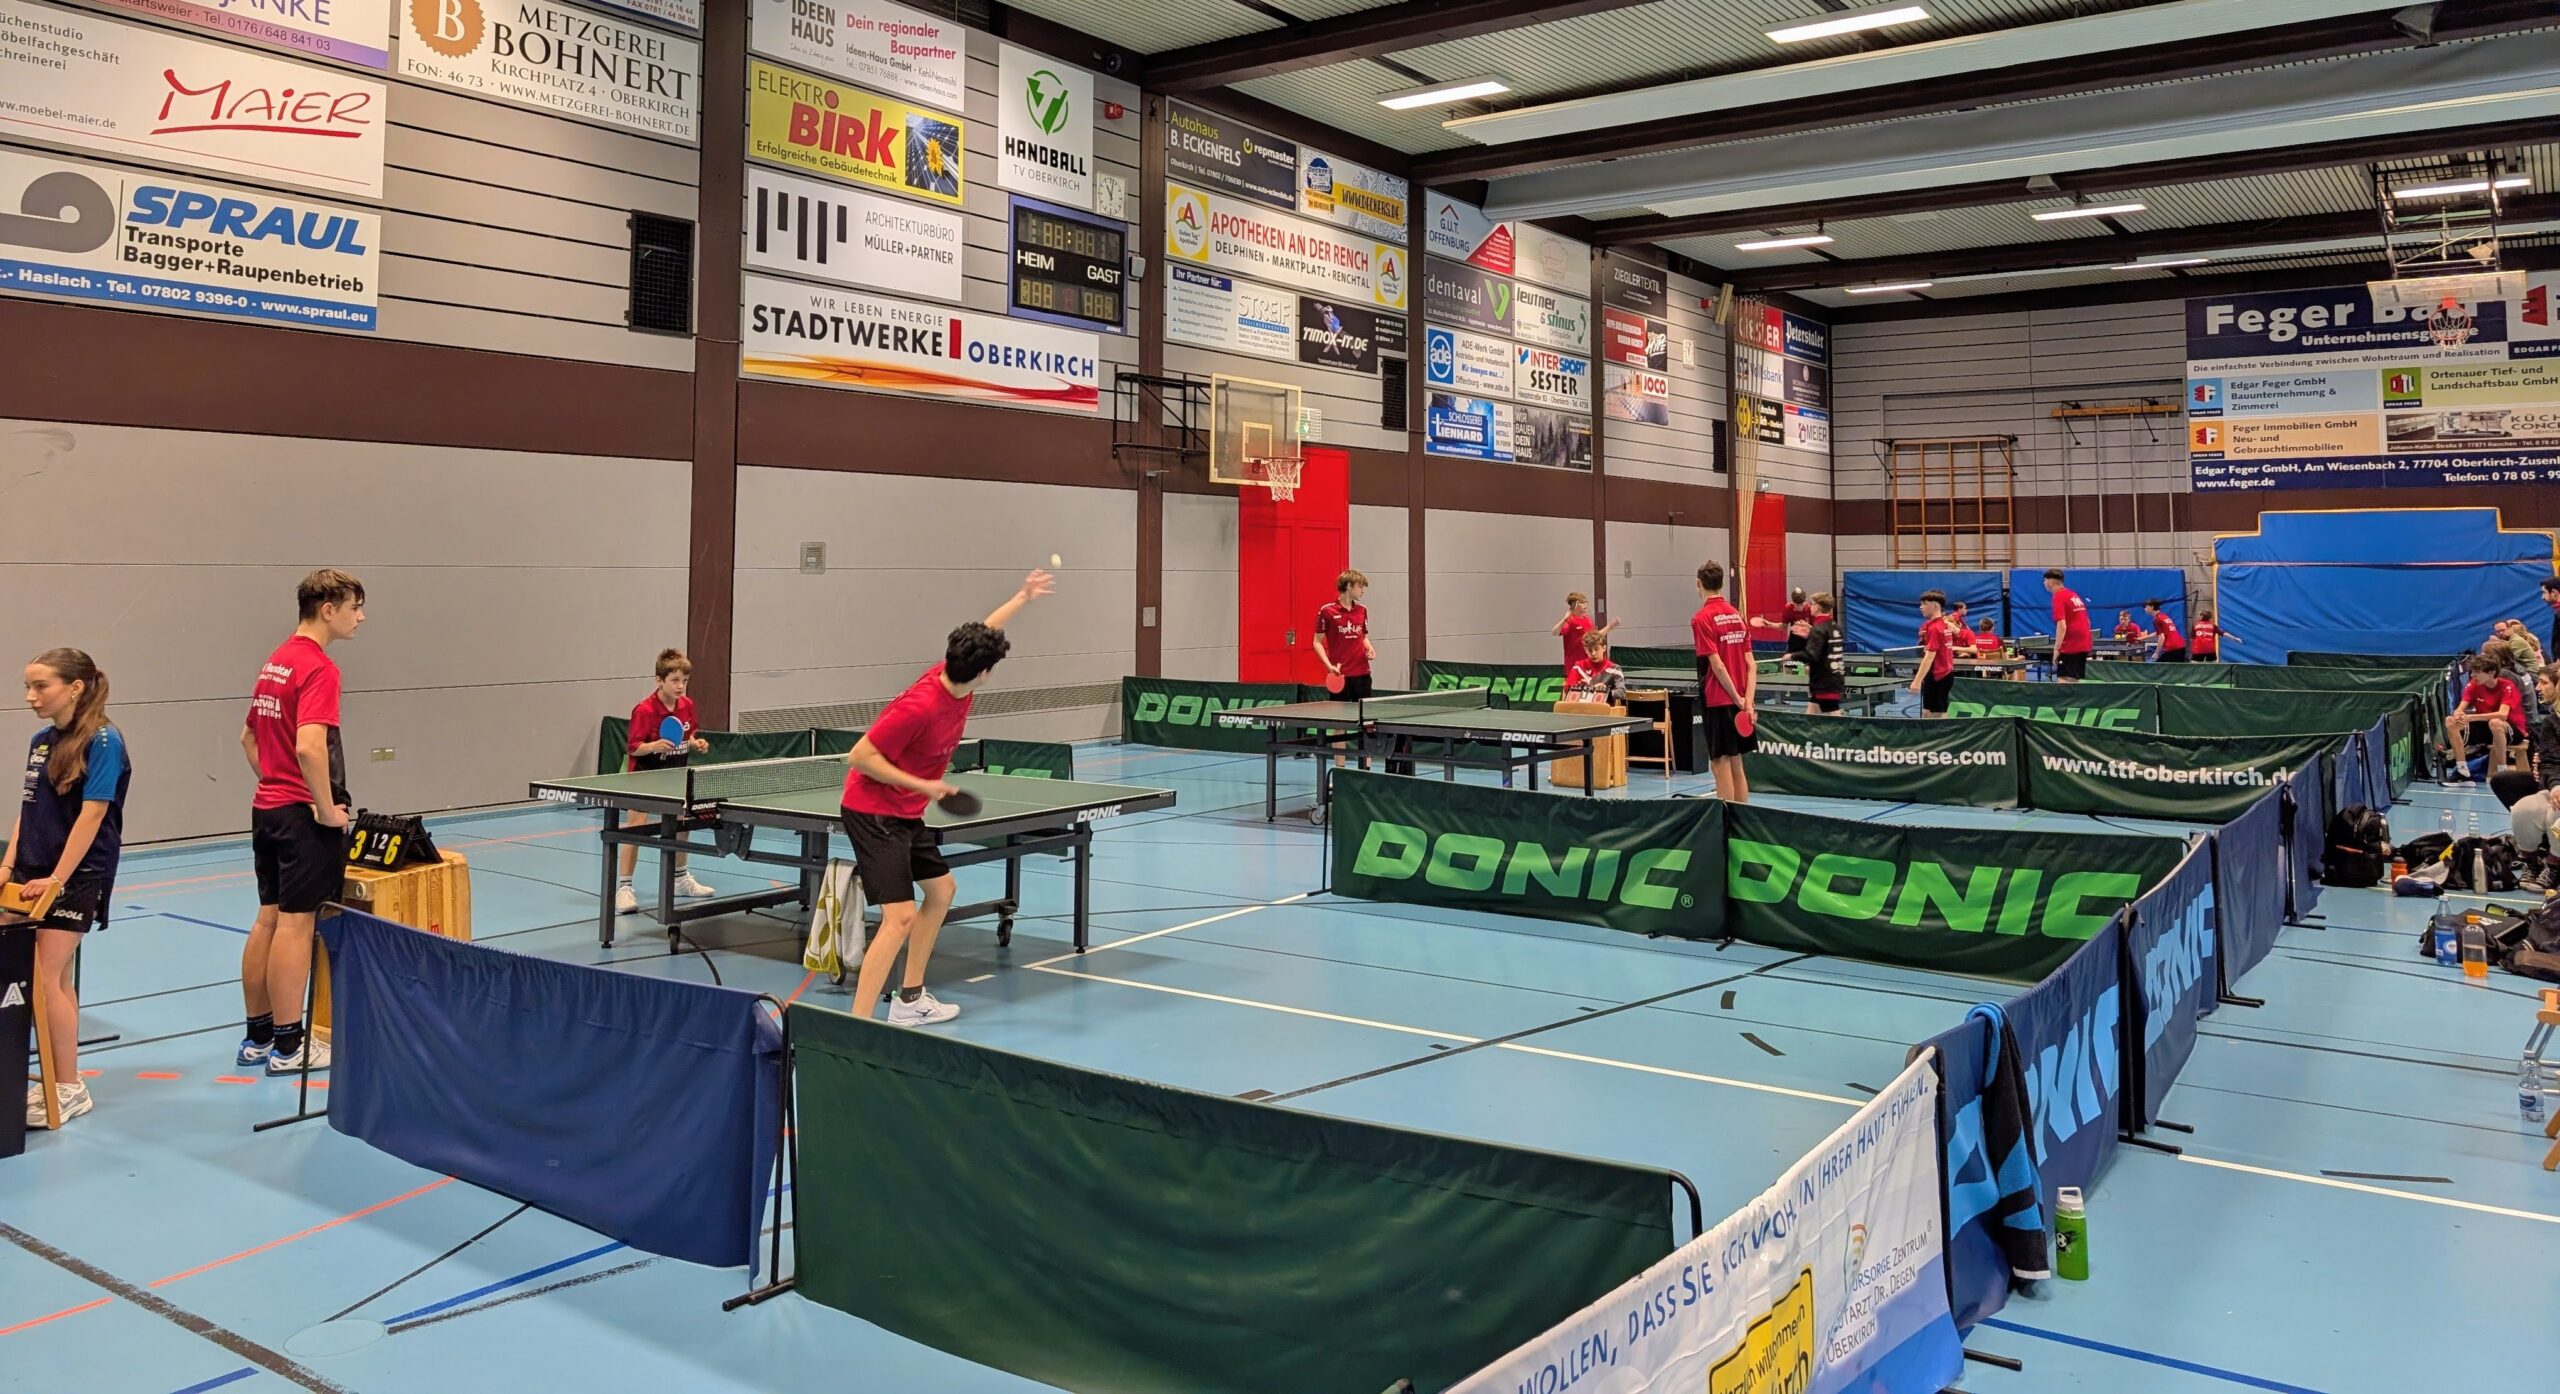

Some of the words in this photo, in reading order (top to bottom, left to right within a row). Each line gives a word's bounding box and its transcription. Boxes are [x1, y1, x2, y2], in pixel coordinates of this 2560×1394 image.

[791, 0, 836, 27] IDEEN
[846, 14, 874, 31] Dein
[879, 20, 940, 39] regionaler
[203, 11, 223, 25] Tel.
[291, 33, 311, 47] 841
[316, 38, 330, 51] 03
[518, 3, 666, 62] METZGEREI
[791, 17, 835, 48] HAUS
[0, 31, 120, 65] öbelfachgeschäft
[492, 22, 691, 101] BOHNERT
[846, 43, 888, 66] Ideen-Haus
[890, 58, 912, 73] GmbH
[891, 40, 957, 60] Baupartner
[407, 58, 443, 78] FON:
[448, 70, 464, 84] 46
[468, 75, 484, 88] 73
[490, 59, 585, 94] KIRCHPLATZ
[589, 86, 597, 97] 4
[611, 89, 690, 119] OBERKIRCH
[758, 71, 840, 110] ELEKTRO
[1171, 111, 1219, 140] Autohaus
[757, 140, 818, 166] Erfolgreiche
[820, 155, 898, 184] Gebäudetechnik
[1005, 136, 1087, 177] HANDBALL
[1171, 129, 1181, 148] B.
[1183, 133, 1242, 167] ECKENFELS
[1254, 145, 1295, 166] repmaster
[1013, 163, 1026, 177] TV
[1028, 167, 1081, 192] OBERKIRCH
[127, 186, 367, 256] SPRAUL
[865, 211, 955, 243] ARCHITEKTURBÜRO
[1440, 218, 1460, 235] G.U.T.
[125, 225, 245, 259] Transporte
[864, 233, 955, 266] MÜLLER+PARTNER
[1211, 211, 1286, 251] APOTHEKEN
[1289, 232, 1306, 257] AN
[1309, 237, 1332, 263] DER
[1334, 245, 1369, 273] RENCH
[1429, 229, 1470, 253] OFFENBURG
[124, 246, 365, 293] Bagger+Raupenbetrieb
[1017, 250, 1055, 272] HEIM
[1087, 264, 1121, 285] GAST
[1176, 269, 1186, 280] Ihr
[1187, 272, 1210, 284] Partner
[1211, 277, 1222, 288] für:
[1215, 240, 1265, 263] DELPHINEN
[1272, 255, 1326, 278] MARKTPLATZ
[1333, 271, 1370, 289] RENCHTAL
[19, 269, 91, 290] Haslach
[107, 280, 137, 295] Tel.
[141, 285, 191, 302] 07802
[196, 291, 248, 308] 9396-0
[261, 301, 369, 324] www.spraul.eu
[1428, 274, 1482, 305] dentaval
[810, 295, 837, 311] WIR
[845, 300, 884, 319] LEBEN
[891, 308, 944, 328] ENERGIE
[2206, 303, 2355, 343] Feger
[752, 304, 944, 358] STADTWERKE
[968, 341, 1095, 379] OBERKIRCH
[1430, 344, 1452, 366] ade
[1489, 346, 1505, 357] GmbH
[2514, 346, 2550, 354] EDGAR
[1531, 350, 1586, 377] INTERSPORT
[2194, 365, 2209, 373] Die
[2211, 363, 2257, 372] einfachste
[2260, 359, 2313, 369] Verbindung
[2316, 356, 2360, 366] zwischen
[2362, 353, 2420, 363] Wohntraum
[2423, 351, 2442, 360] und
[2445, 349, 2500, 358] Realisation
[2431, 369, 2488, 379] Ortenauer
[2491, 368, 2517, 376] Tief-
[2522, 366, 2544, 375] und
[1531, 370, 1578, 396] SESTER
[2231, 381, 2259, 391] Edgar
[2262, 380, 2291, 390] Feger
[2294, 377, 2327, 387] GmbH
[2232, 390, 2326, 400] Bauunternehmung
[2329, 388, 2337, 396] &
[2432, 379, 2519, 391] Landschaftsbau
[2523, 377, 2559, 386] GmbH
[2232, 402, 2279, 411] Zimmerei
[1515, 423, 1536, 436] BAUEN
[1515, 435, 1531, 447] DEIN
[1807, 424, 1827, 443] MEIER
[2233, 424, 2261, 434] Feger
[2264, 422, 2321, 432] Immobilien
[2325, 420, 2358, 429] GmbH
[2261, 434, 2280, 442] und
[1515, 447, 1533, 458] HAUS
[2234, 444, 2344, 454] Gebrauchtimmobilien
[2195, 466, 2226, 477] Edgar
[2229, 465, 2260, 475] Feger
[2262, 464, 2302, 474] GmbH,
[2305, 463, 2325, 472] Am
[2327, 459, 2396, 471] Wiesenbach
[2399, 460, 2410, 471] 2,
[2413, 459, 2449, 469] 77704
[2196, 478, 2276, 489] www.feger.de
[2443, 472, 2490, 482] Telefon:
[2492, 472, 2500, 481] 0
[2503, 471, 2518, 481] 78
[2521, 471, 2536, 480] 05
[1219, 716, 1254, 725] DONIC
[1502, 732, 1546, 744] DONIC
[1611, 726, 1630, 736] DONIC
[537, 788, 578, 803] DONIC
[584, 797, 614, 808] DELHI
[691, 802, 718, 811] DONIC
[1076, 804, 1122, 823] DONIC
[349, 830, 367, 860] 3
[372, 833, 379, 849] 1
[379, 834, 389, 850] 2
[384, 835, 402, 865] 6
[1352, 820, 1694, 911] DONIC
[1729, 836, 2141, 941] DONIC
[53, 908, 84, 921] JOOLA
[1629, 1284, 1677, 1347] DASS
[1818, 1147, 1852, 1193] IHRER
[1874, 1285, 1890, 1307] DR.
[1890, 1264, 1917, 1295] DEGEN
[1826, 1316, 1876, 1364] OBERKIRCH
